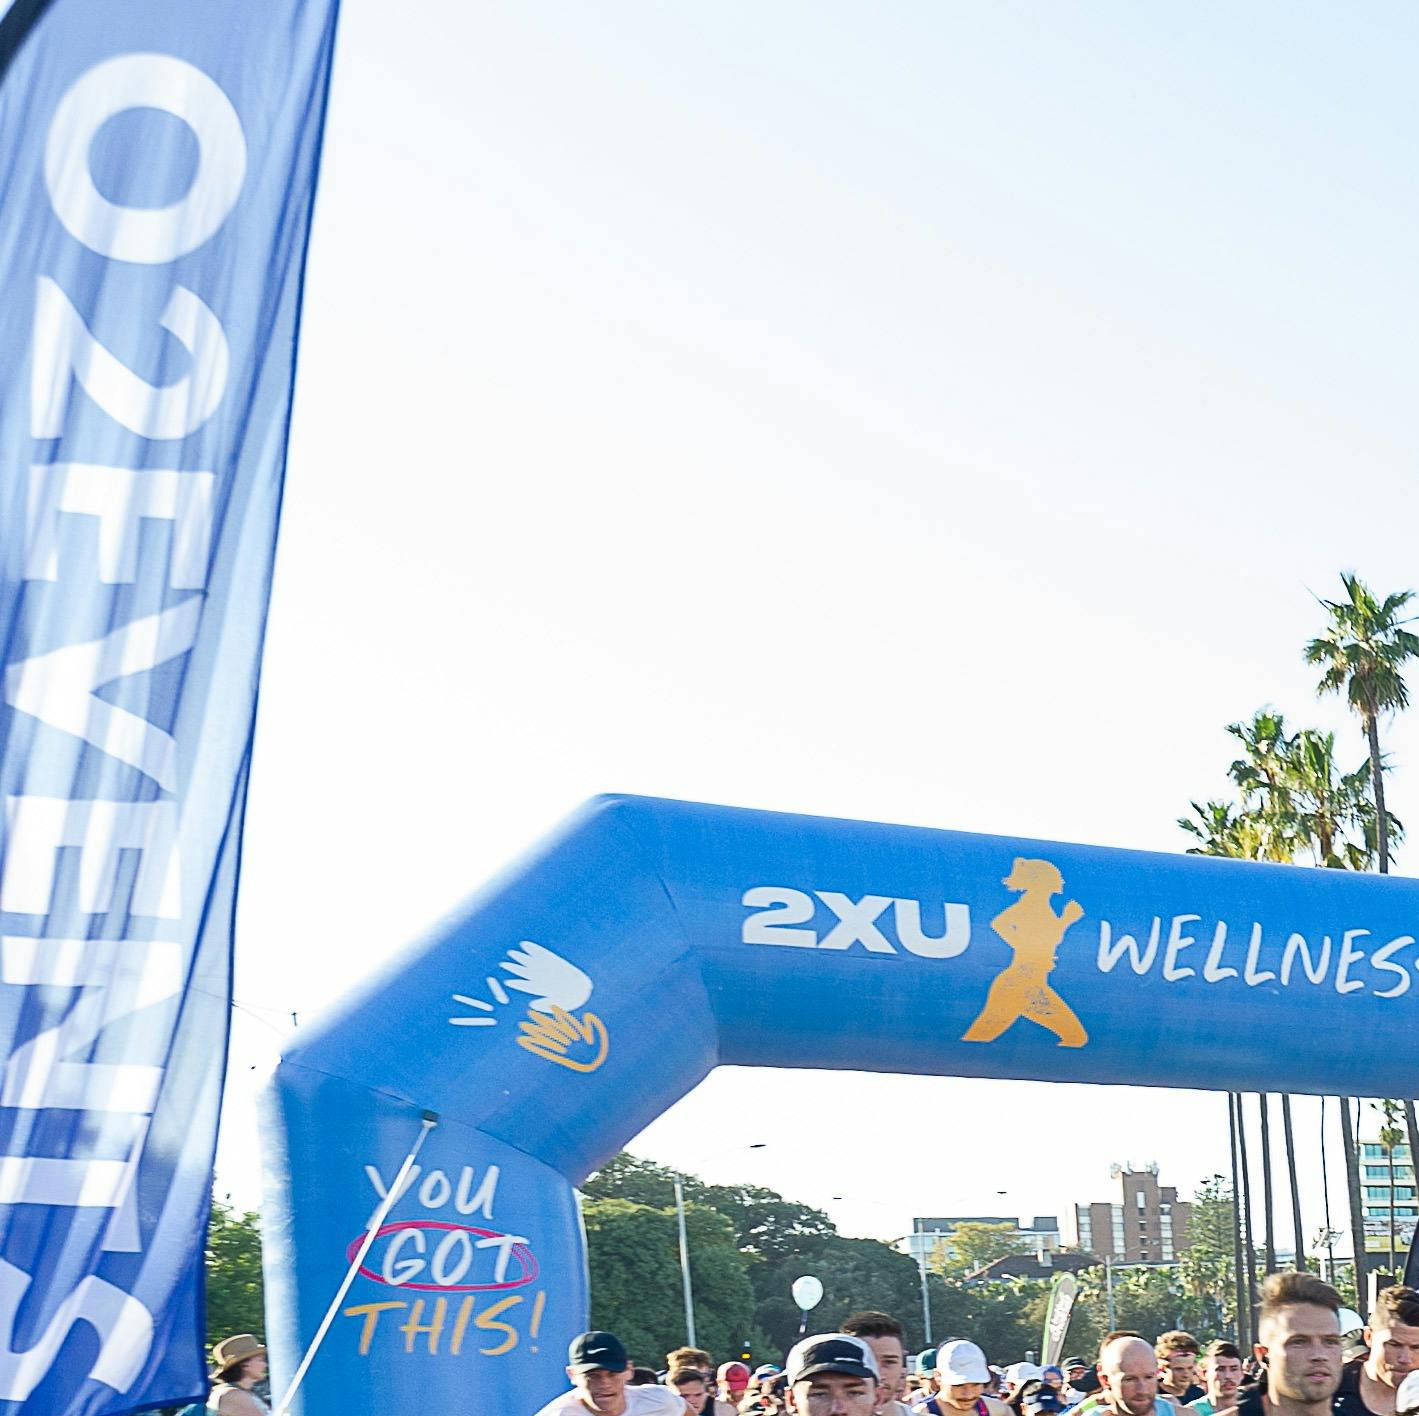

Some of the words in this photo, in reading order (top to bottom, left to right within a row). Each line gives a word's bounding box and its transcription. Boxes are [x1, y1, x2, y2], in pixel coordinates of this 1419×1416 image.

[0, 52, 247, 1402] O2EVENTS
[741, 886, 971, 959] 2XU
[364, 1164, 500, 1230] YOU
[382, 1227, 530, 1286] GOT
[344, 1290, 546, 1356] THIS!
